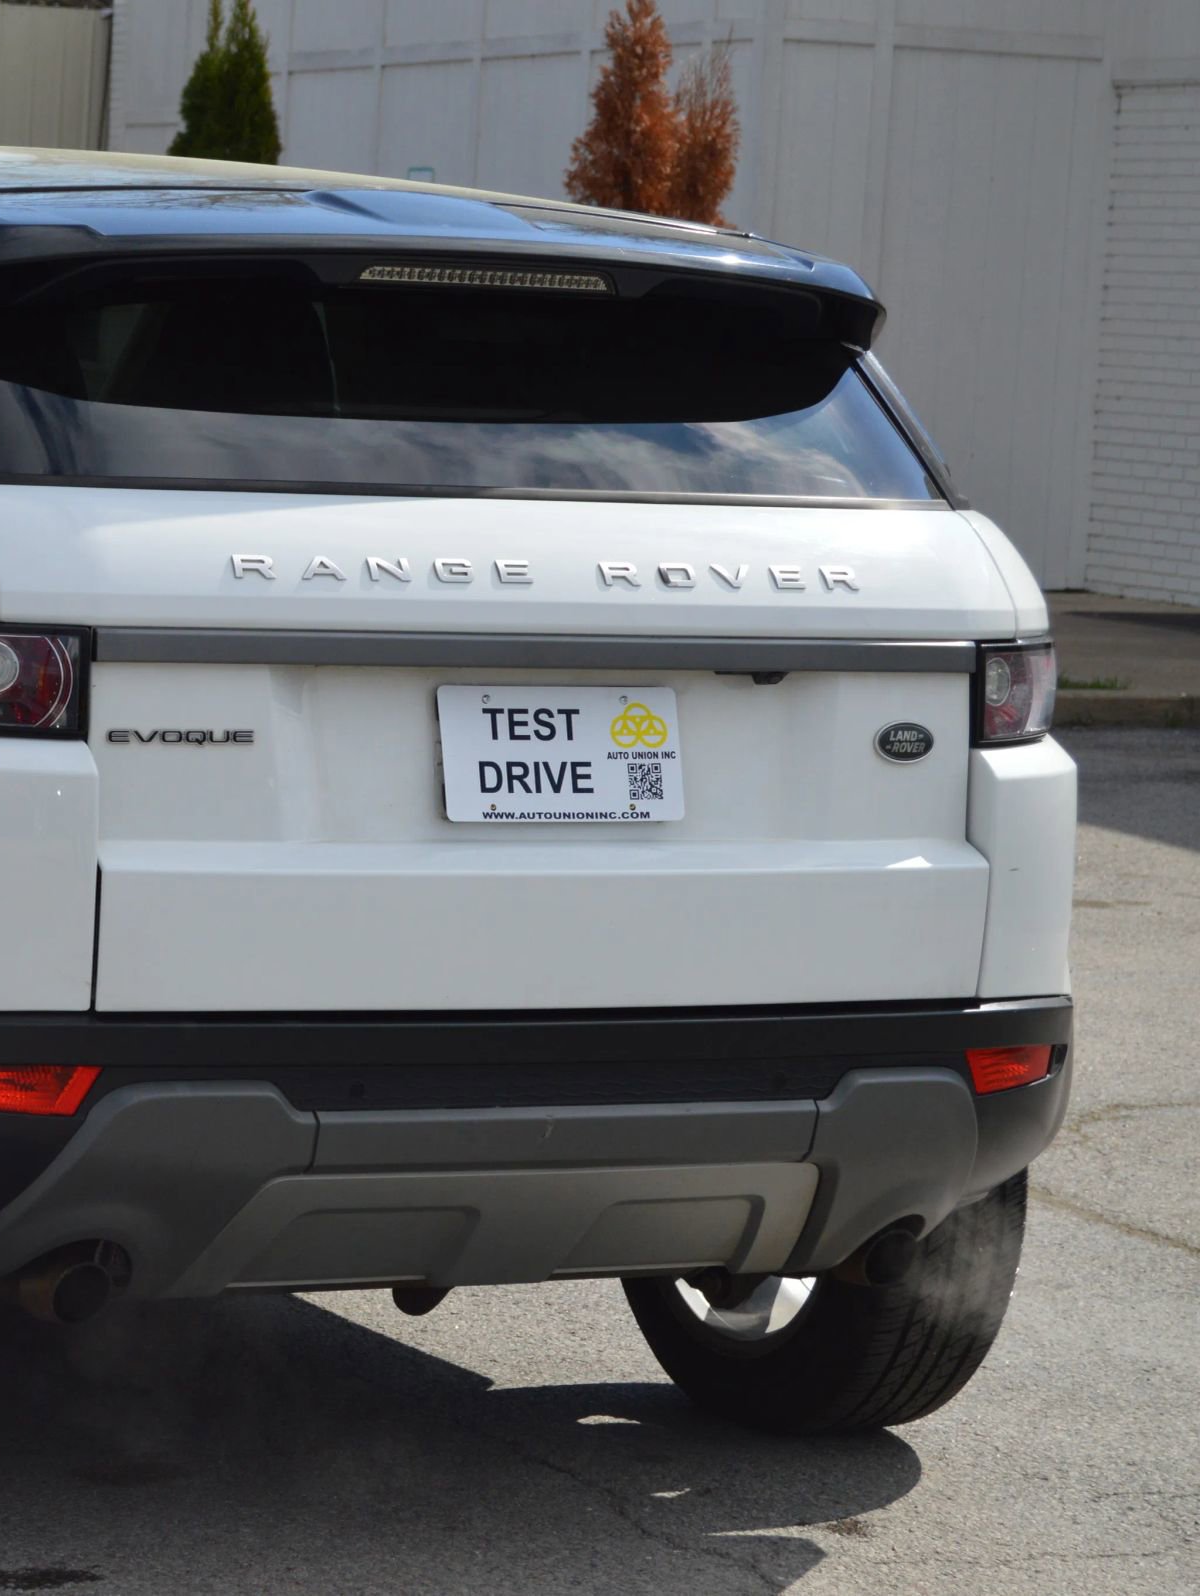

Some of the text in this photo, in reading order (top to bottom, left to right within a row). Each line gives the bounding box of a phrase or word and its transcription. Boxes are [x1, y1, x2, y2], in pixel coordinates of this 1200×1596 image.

[230, 554, 860, 591] RANGE ROVER
[482, 708, 580, 741] TEST
[107, 730, 254, 746] EVOQUE
[607, 751, 676, 760] AUTO UNION INC
[478, 761, 594, 794] DRIVE
[482, 811, 651, 820] WWW.AUTOUNIONINC.COM
